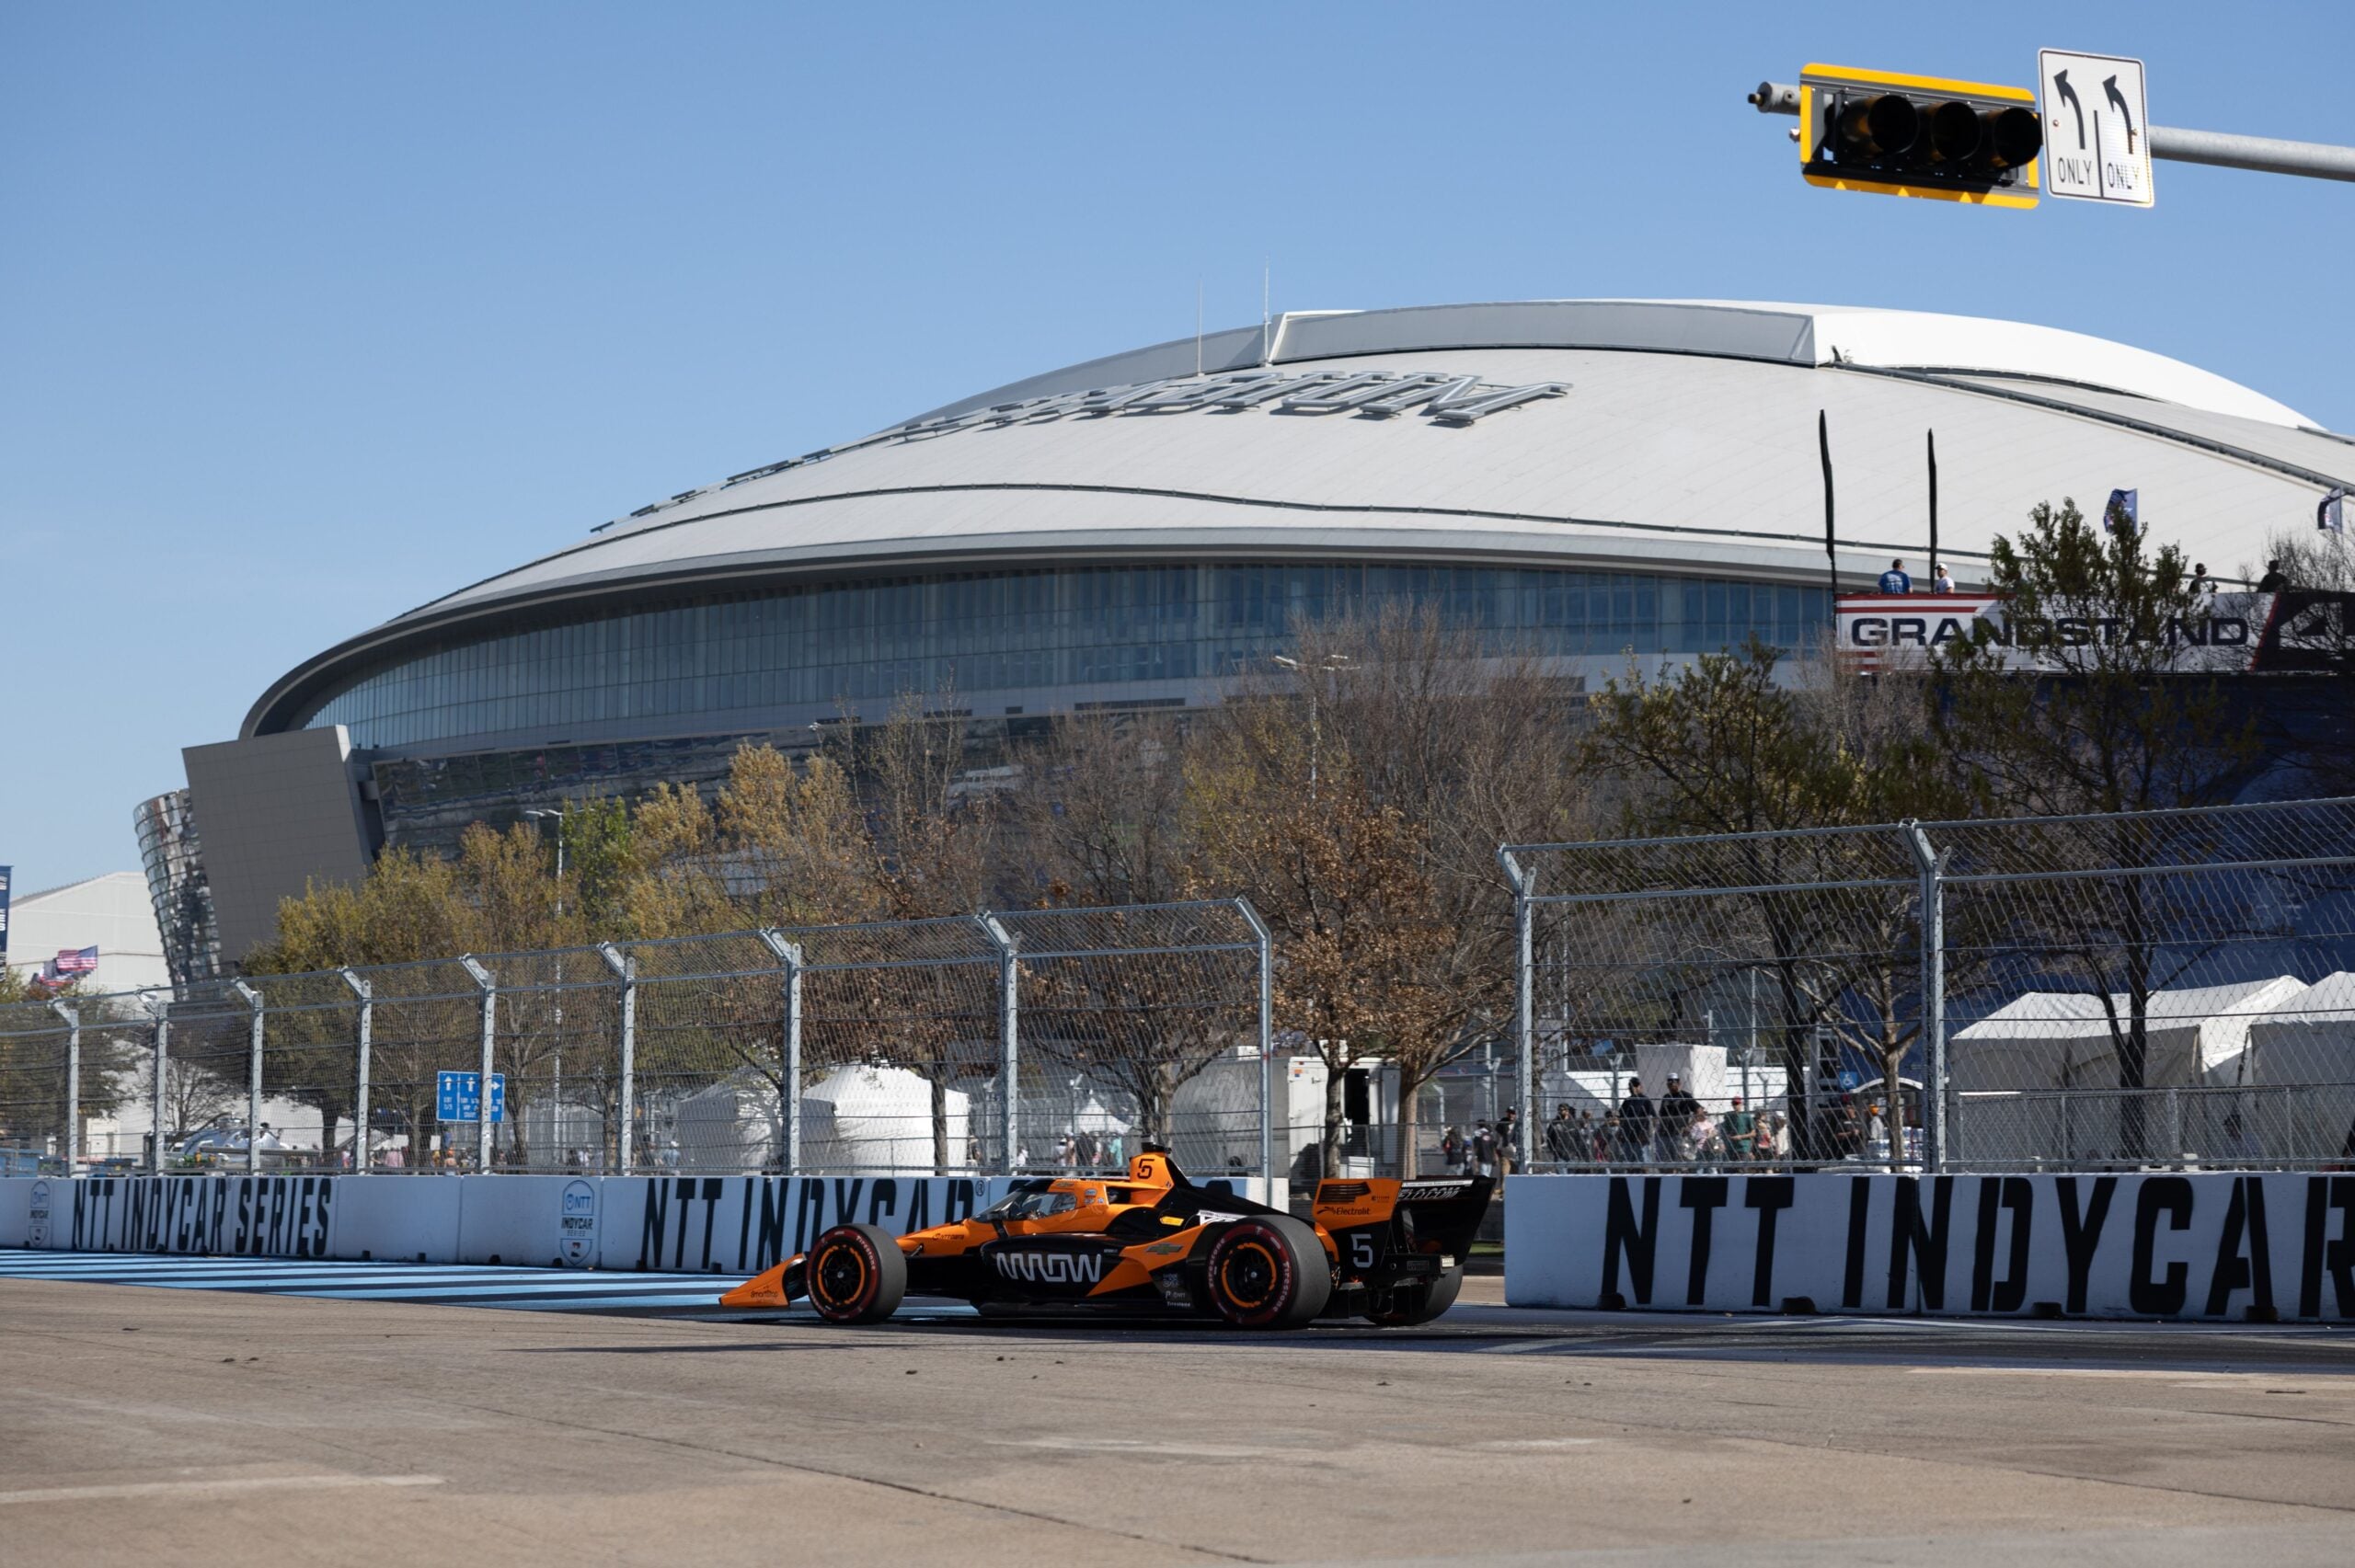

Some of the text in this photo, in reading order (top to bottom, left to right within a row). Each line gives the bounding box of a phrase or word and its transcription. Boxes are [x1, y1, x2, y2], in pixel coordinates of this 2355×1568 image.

[2058, 157, 2092, 186] ONLY
[2107, 162, 2140, 190] ONLY
[1137, 1158, 1155, 1179] 5
[72, 1178, 114, 1249] NTT
[121, 1177, 226, 1253] INDYCAR
[236, 1177, 331, 1255] SERIES
[574, 1196, 592, 1208] NTT
[1336, 1206, 1371, 1216] Electrolit
[561, 1217, 593, 1230] INDYCAR
[641, 1178, 723, 1269] NTT
[1350, 1233, 1373, 1268] 5
[1602, 1176, 2355, 1318] NTT INDYCAR
